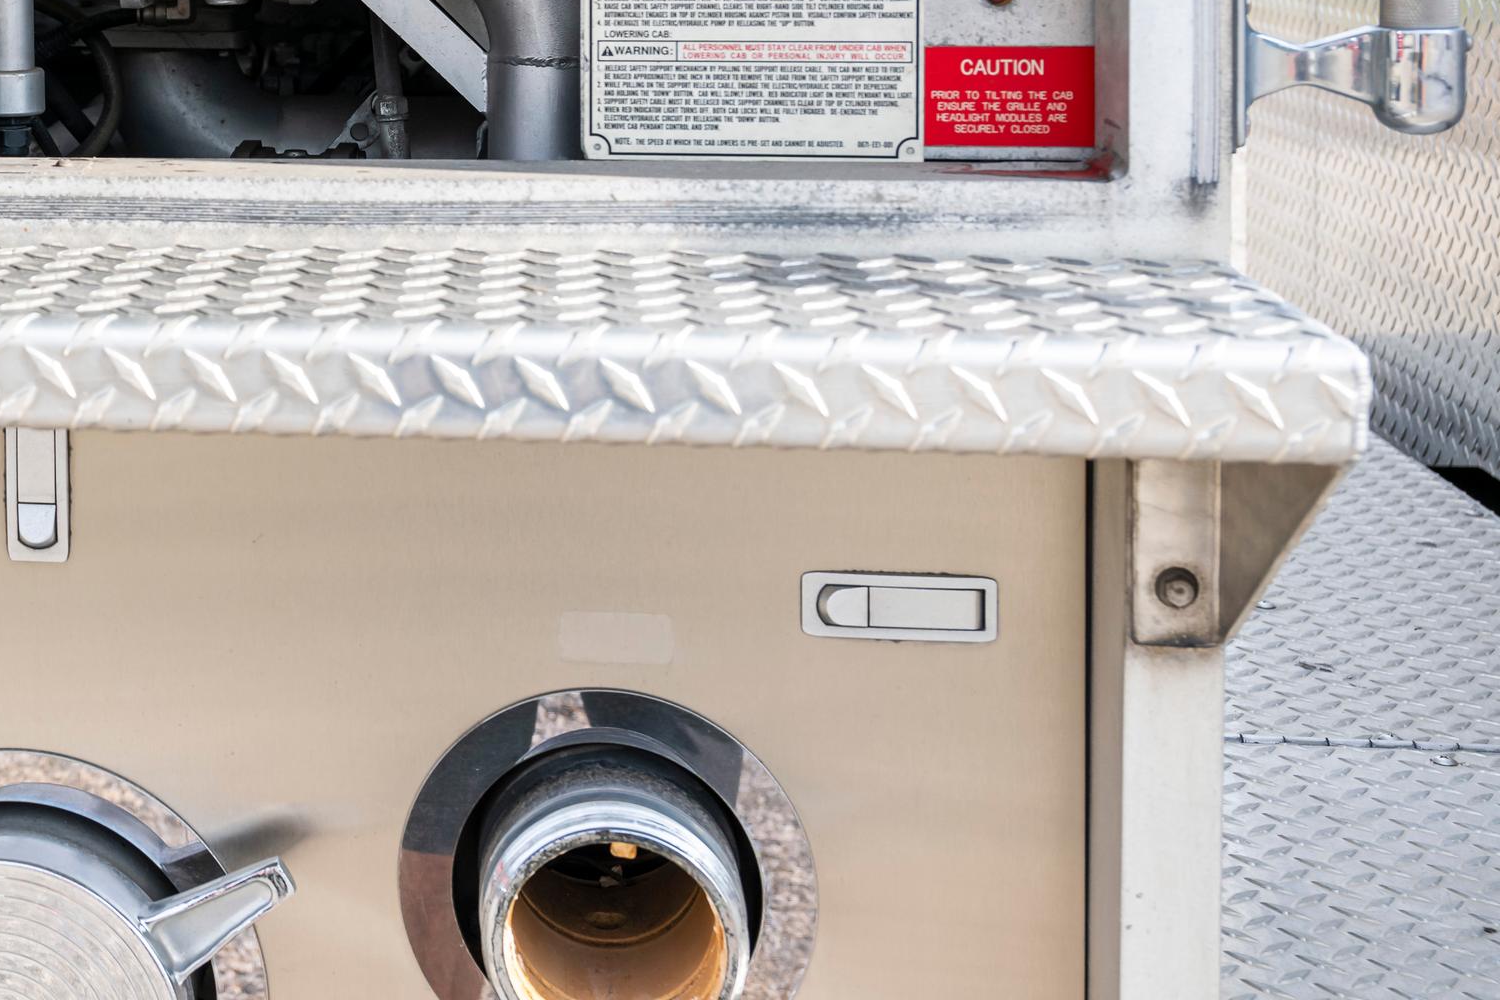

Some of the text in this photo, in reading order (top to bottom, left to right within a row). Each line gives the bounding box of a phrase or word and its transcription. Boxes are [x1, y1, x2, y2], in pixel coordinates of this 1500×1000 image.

[604, 30, 671, 38] LOWERING CAB:
[614, 46, 674, 56] WARNING:
[960, 60, 1044, 76] CAUTION
[930, 91, 1073, 99] PRIOR TO TILTING THE CAB
[937, 103, 1066, 111] ENSURE THE GRILLE AND
[936, 114, 1066, 122] HEADLIGHT MODULES ARE
[954, 125, 1049, 133] SECURELY CLOSED
